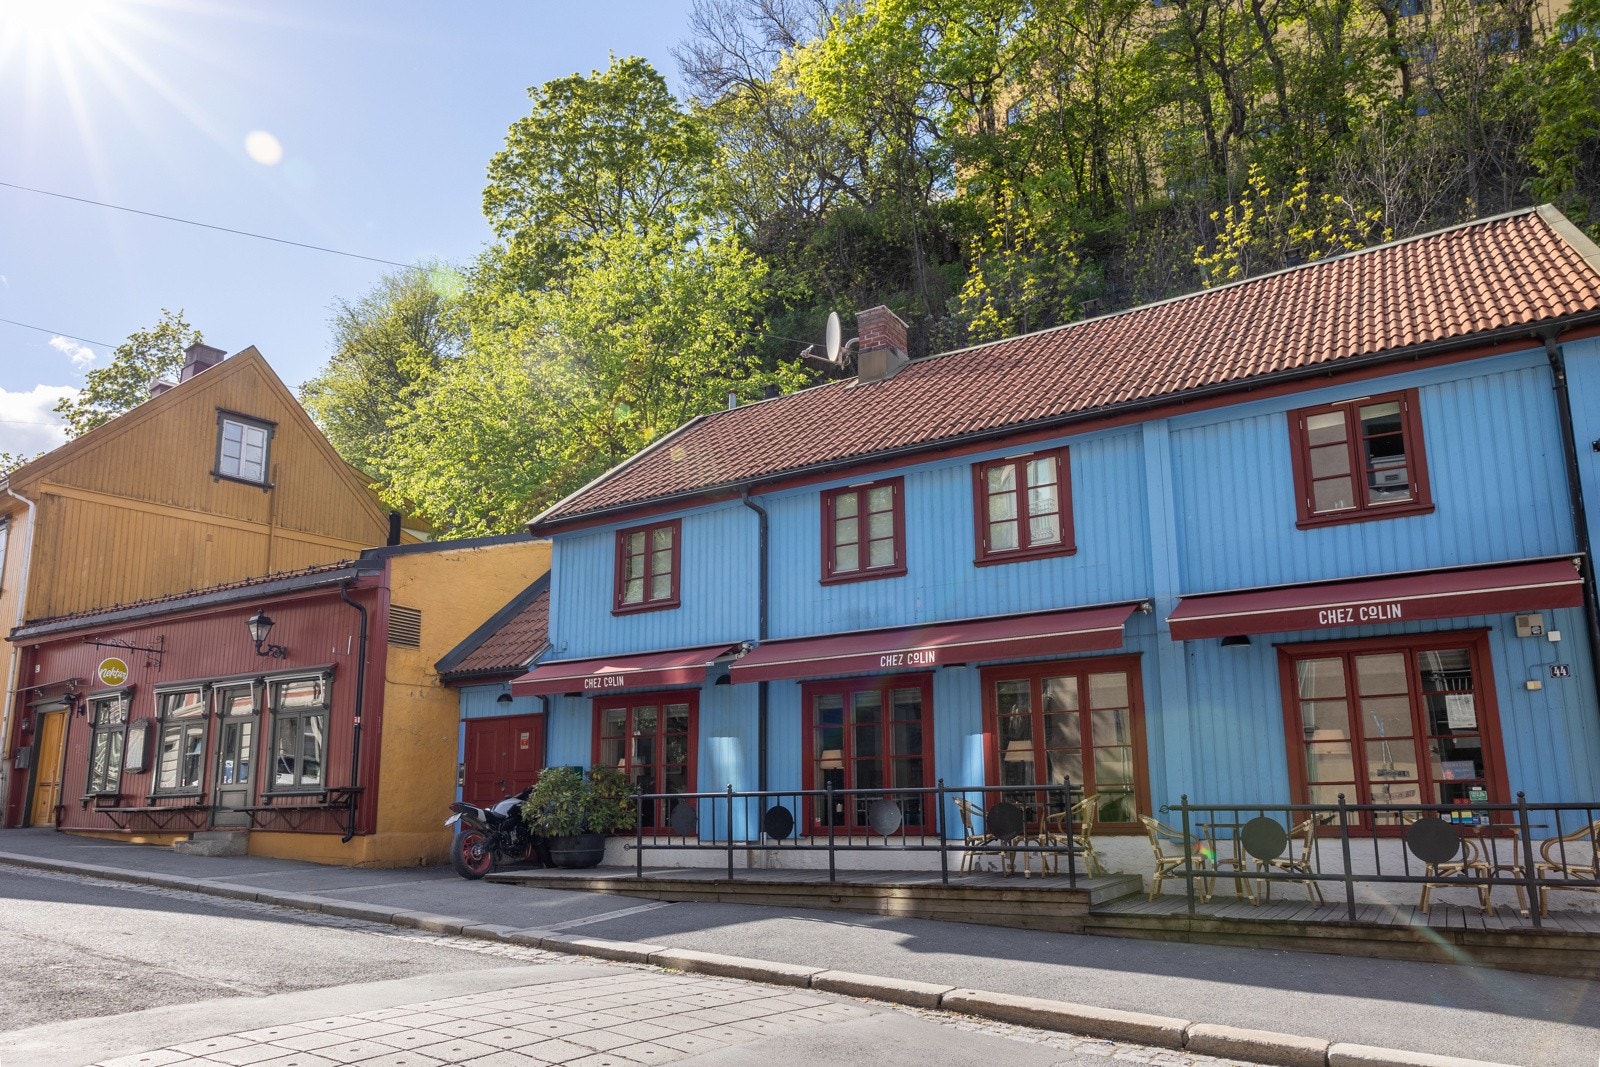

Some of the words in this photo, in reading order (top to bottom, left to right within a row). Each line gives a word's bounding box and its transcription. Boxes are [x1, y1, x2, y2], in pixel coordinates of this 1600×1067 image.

[1318, 608, 1354, 625] CHEZ
[880, 654, 904, 667] CHEZ
[1553, 666, 1567, 676] 44
[584, 677, 602, 689] CHEZ
